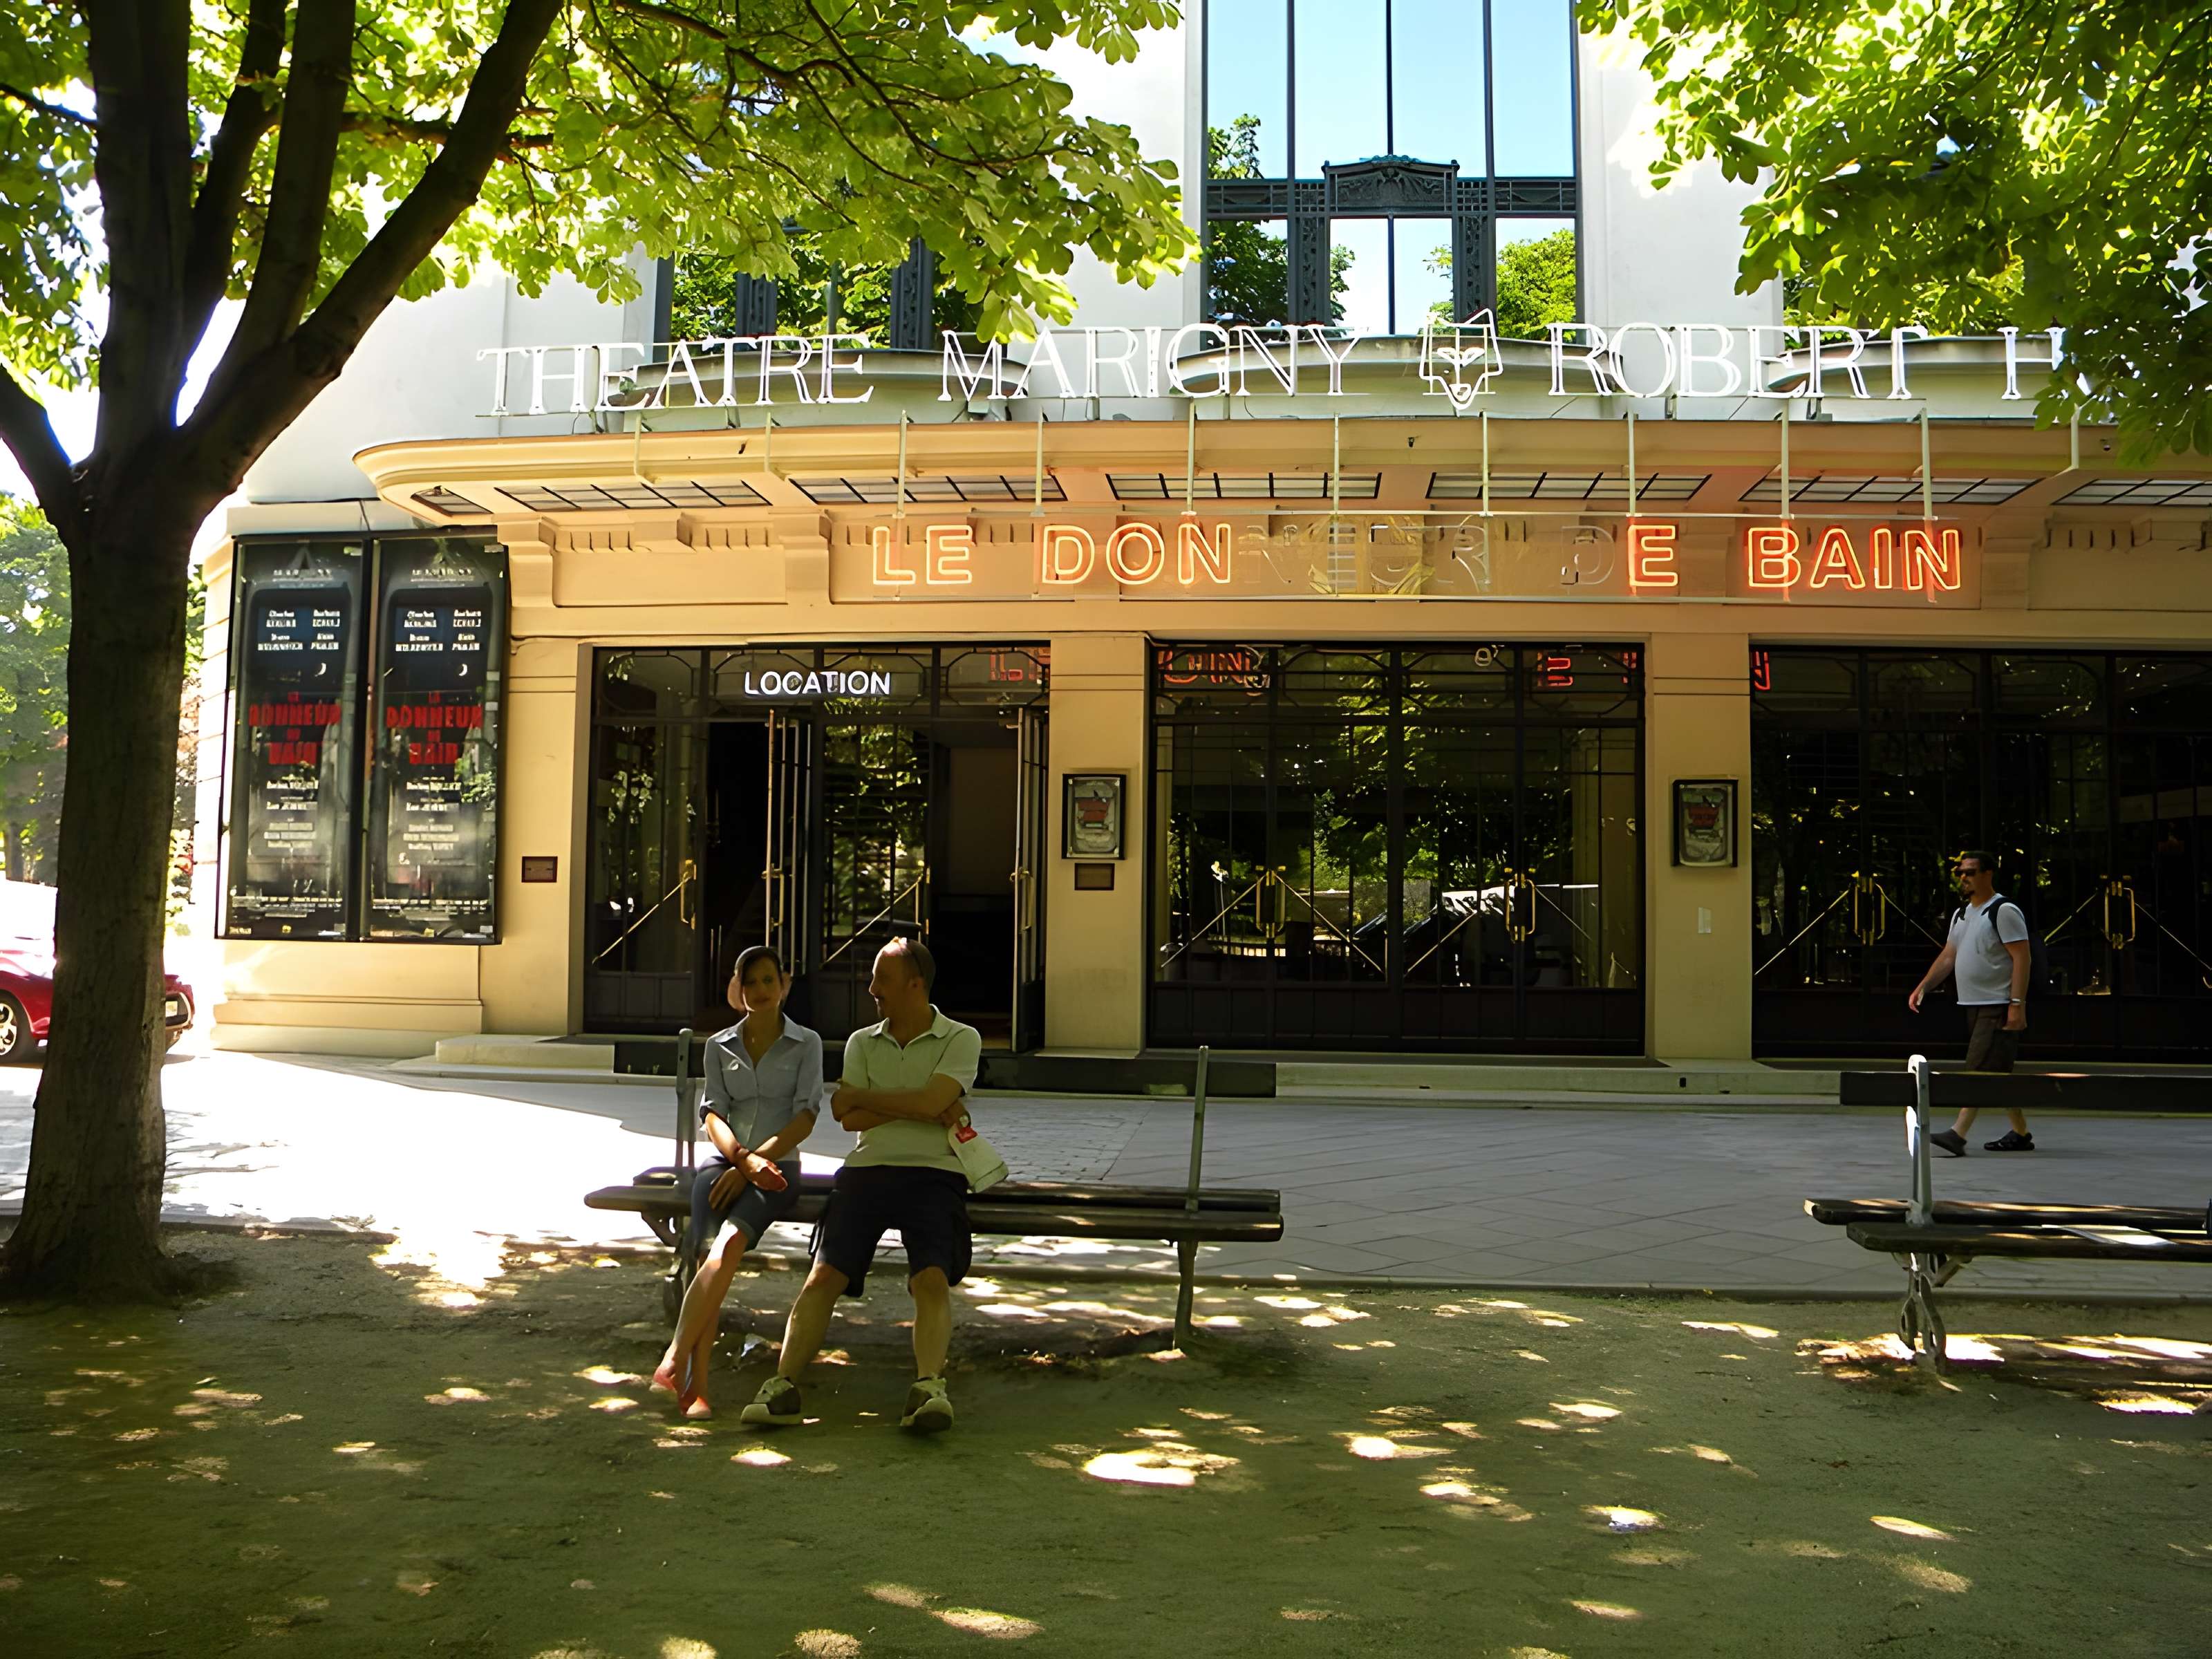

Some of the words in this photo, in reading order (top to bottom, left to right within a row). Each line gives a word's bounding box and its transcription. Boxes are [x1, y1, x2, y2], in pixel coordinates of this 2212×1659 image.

[938, 324, 1372, 402] MARIGNY
[1545, 323, 1929, 400] ROBERT
[872, 524, 973, 586] LE
[1747, 523, 1962, 591] BAIN
[744, 671, 891, 695] LOCATION
